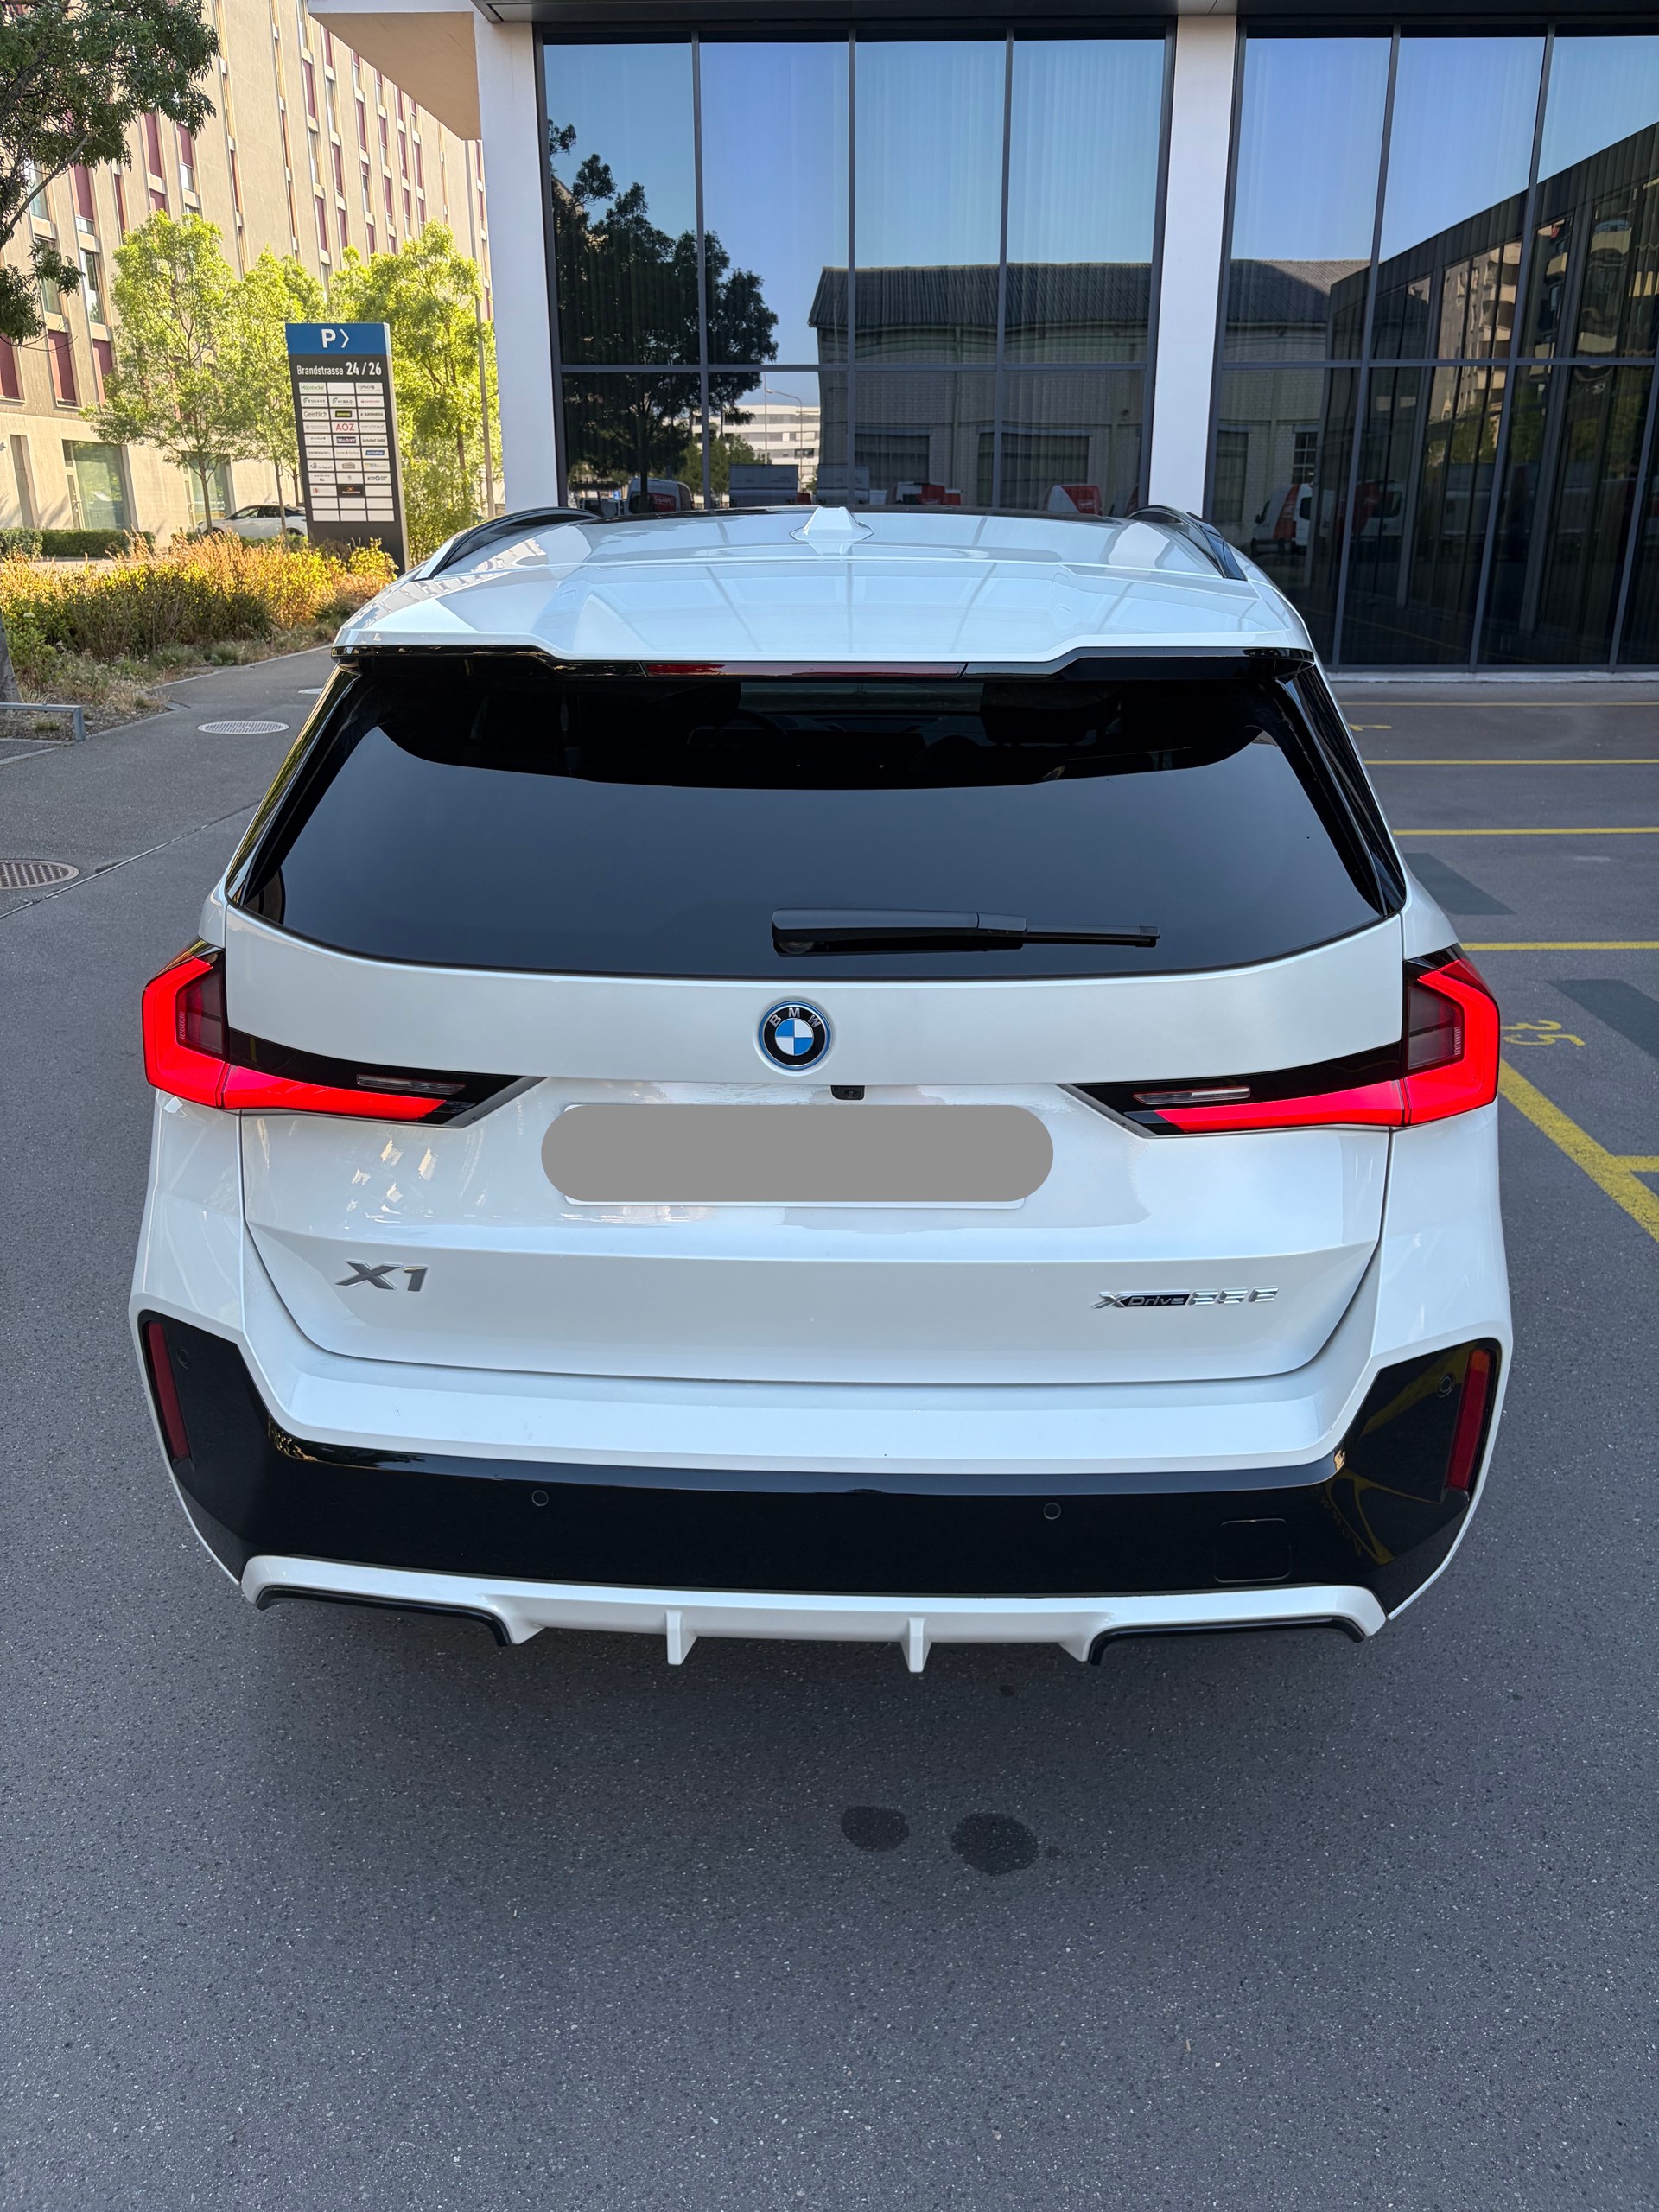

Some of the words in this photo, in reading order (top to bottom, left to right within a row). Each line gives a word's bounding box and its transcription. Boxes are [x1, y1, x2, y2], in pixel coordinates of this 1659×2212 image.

[321, 328, 336, 348] P
[296, 365, 344, 376] Brandstrasse
[335, 423, 355, 431] AOZ
[768, 1007, 822, 1028] BMW
[334, 1259, 429, 1292] X1
